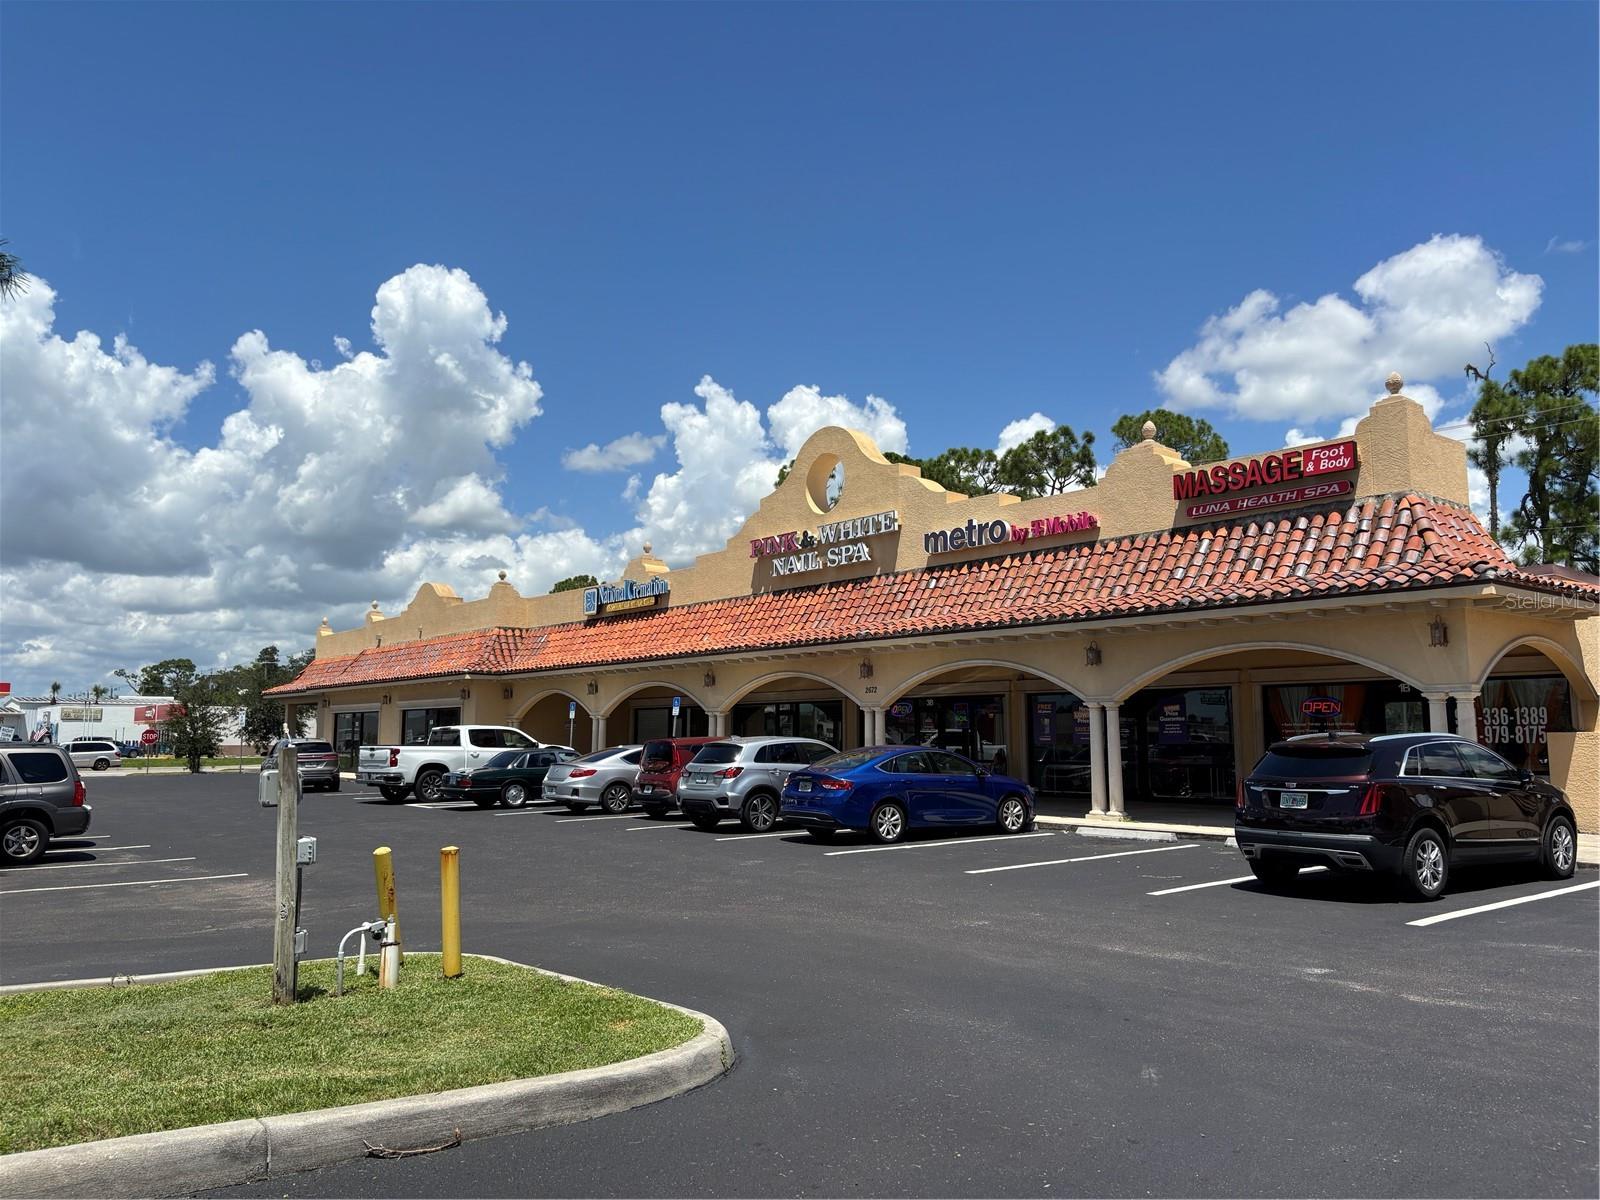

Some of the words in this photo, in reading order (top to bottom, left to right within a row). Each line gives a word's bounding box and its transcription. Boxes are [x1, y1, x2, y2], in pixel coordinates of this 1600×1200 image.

[1306, 462, 1314, 472] &
[1319, 456, 1350, 471] Body
[1311, 445, 1344, 460] Foot
[1173, 451, 1302, 500] MASSAGE
[1192, 502, 1231, 516] LUNA
[1237, 490, 1297, 508] HEALTH
[1303, 483, 1340, 498] SPA
[750, 532, 797, 558] PINK
[800, 530, 816, 549] &
[816, 511, 898, 545] WHITE
[924, 518, 1007, 555] metro
[1010, 525, 1029, 544] by
[771, 550, 822, 577] NAIL
[827, 542, 871, 568] SPA
[598, 582, 626, 605] National
[627, 576, 668, 601] Cremation
[892, 705, 912, 714] OPEN
[1303, 702, 1341, 713] OPEN
